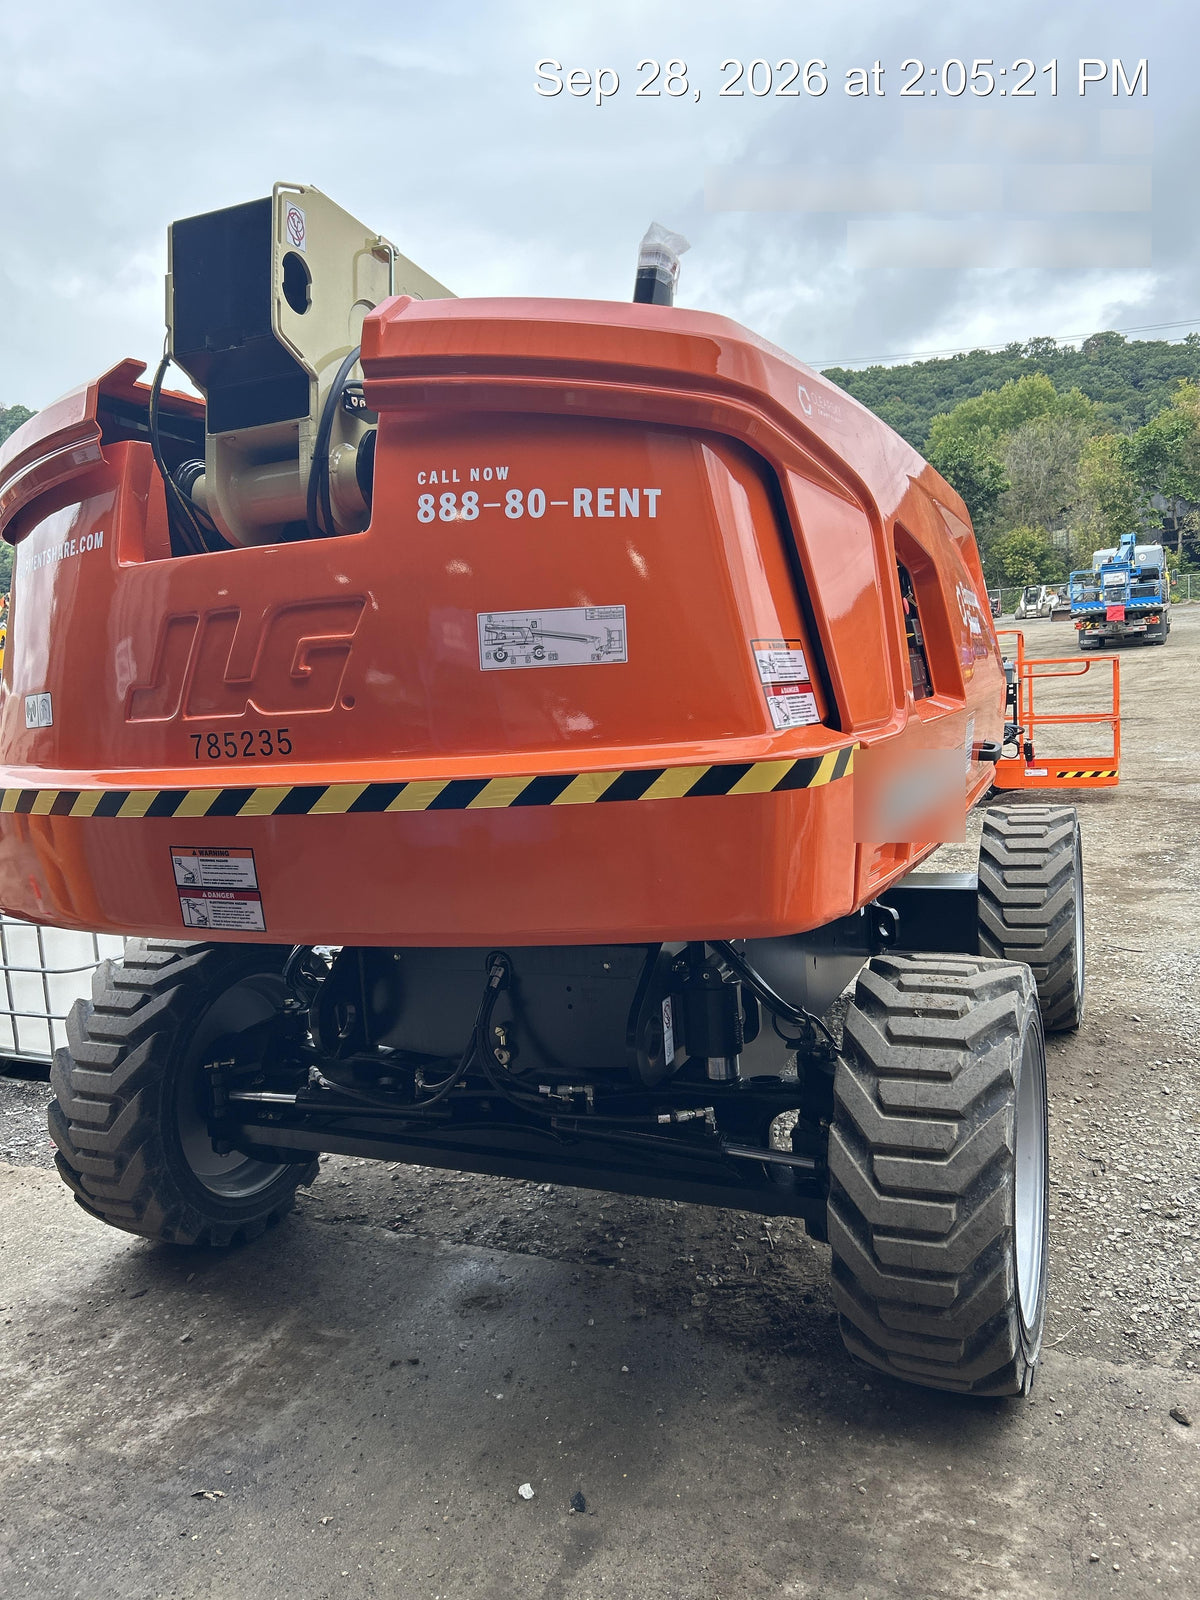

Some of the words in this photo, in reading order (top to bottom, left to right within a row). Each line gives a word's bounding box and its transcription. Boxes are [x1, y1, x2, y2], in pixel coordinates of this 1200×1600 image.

[417, 469, 461, 485] CALL
[470, 466, 509, 482] NOW
[417, 488, 661, 523] 888-80-RENT
[126, 594, 367, 723] JLG
[190, 728, 293, 760] 785235
